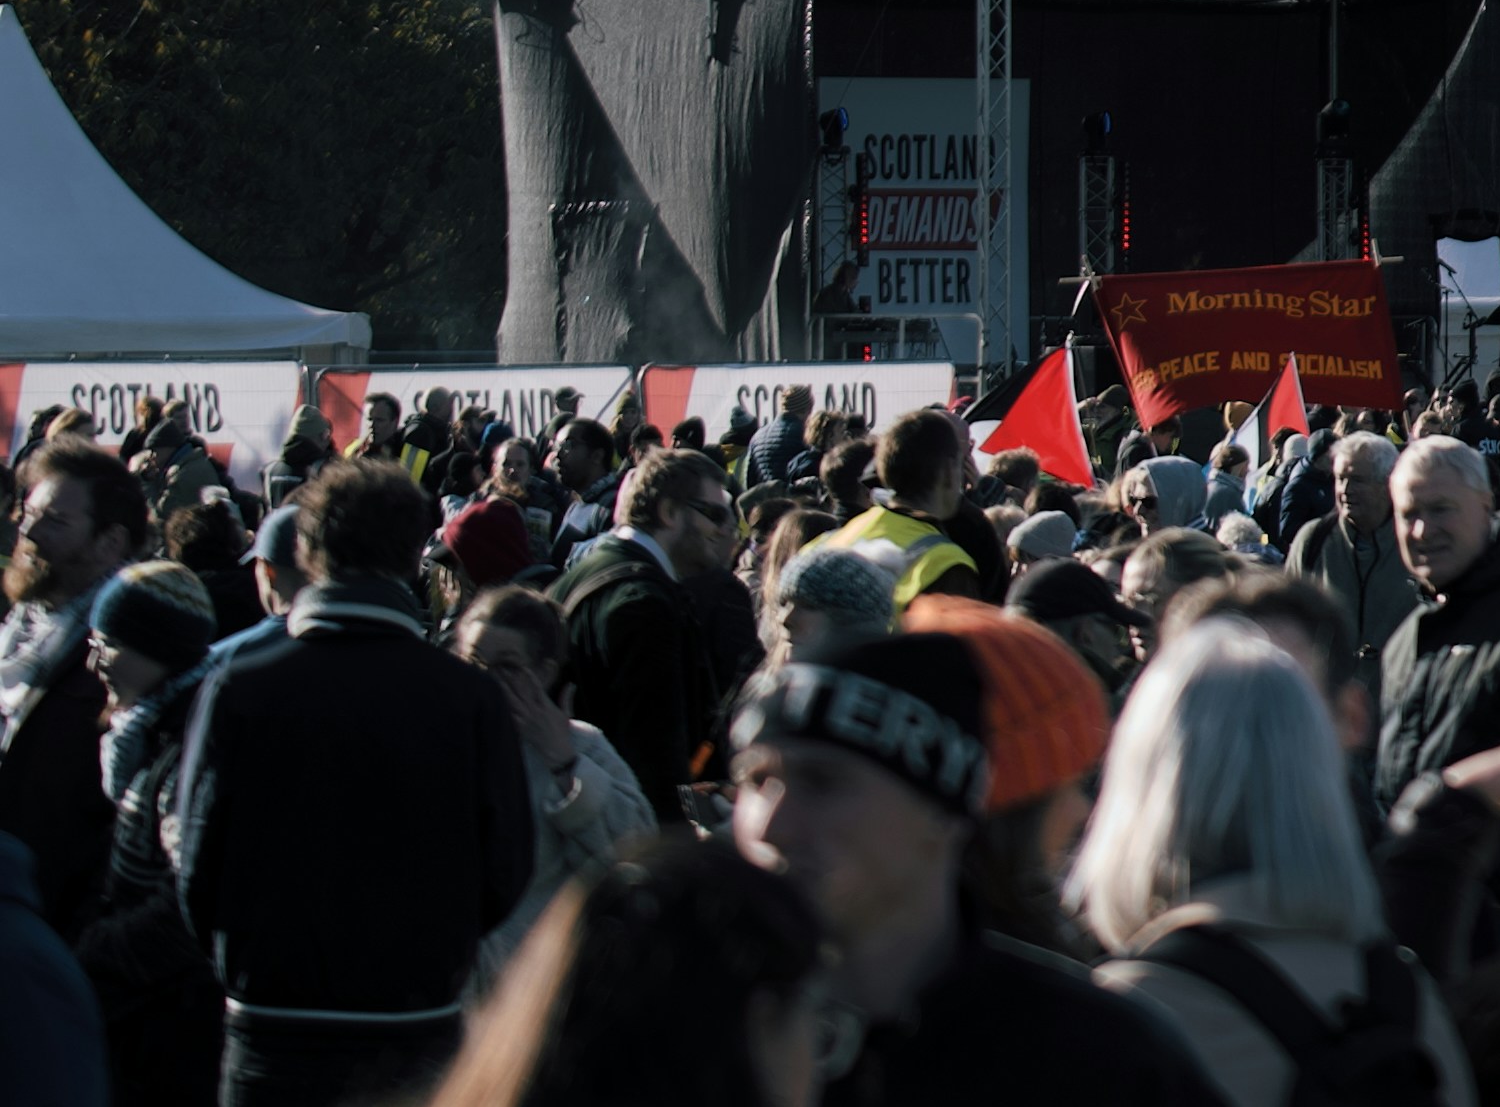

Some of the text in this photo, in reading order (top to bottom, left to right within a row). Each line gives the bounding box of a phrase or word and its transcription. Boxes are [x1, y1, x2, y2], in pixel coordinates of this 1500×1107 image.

[878, 257, 971, 304] BETTER
[1166, 289, 1377, 317] Morning Star
[1159, 351, 1220, 383] PEACE
[1230, 351, 1271, 371] AND
